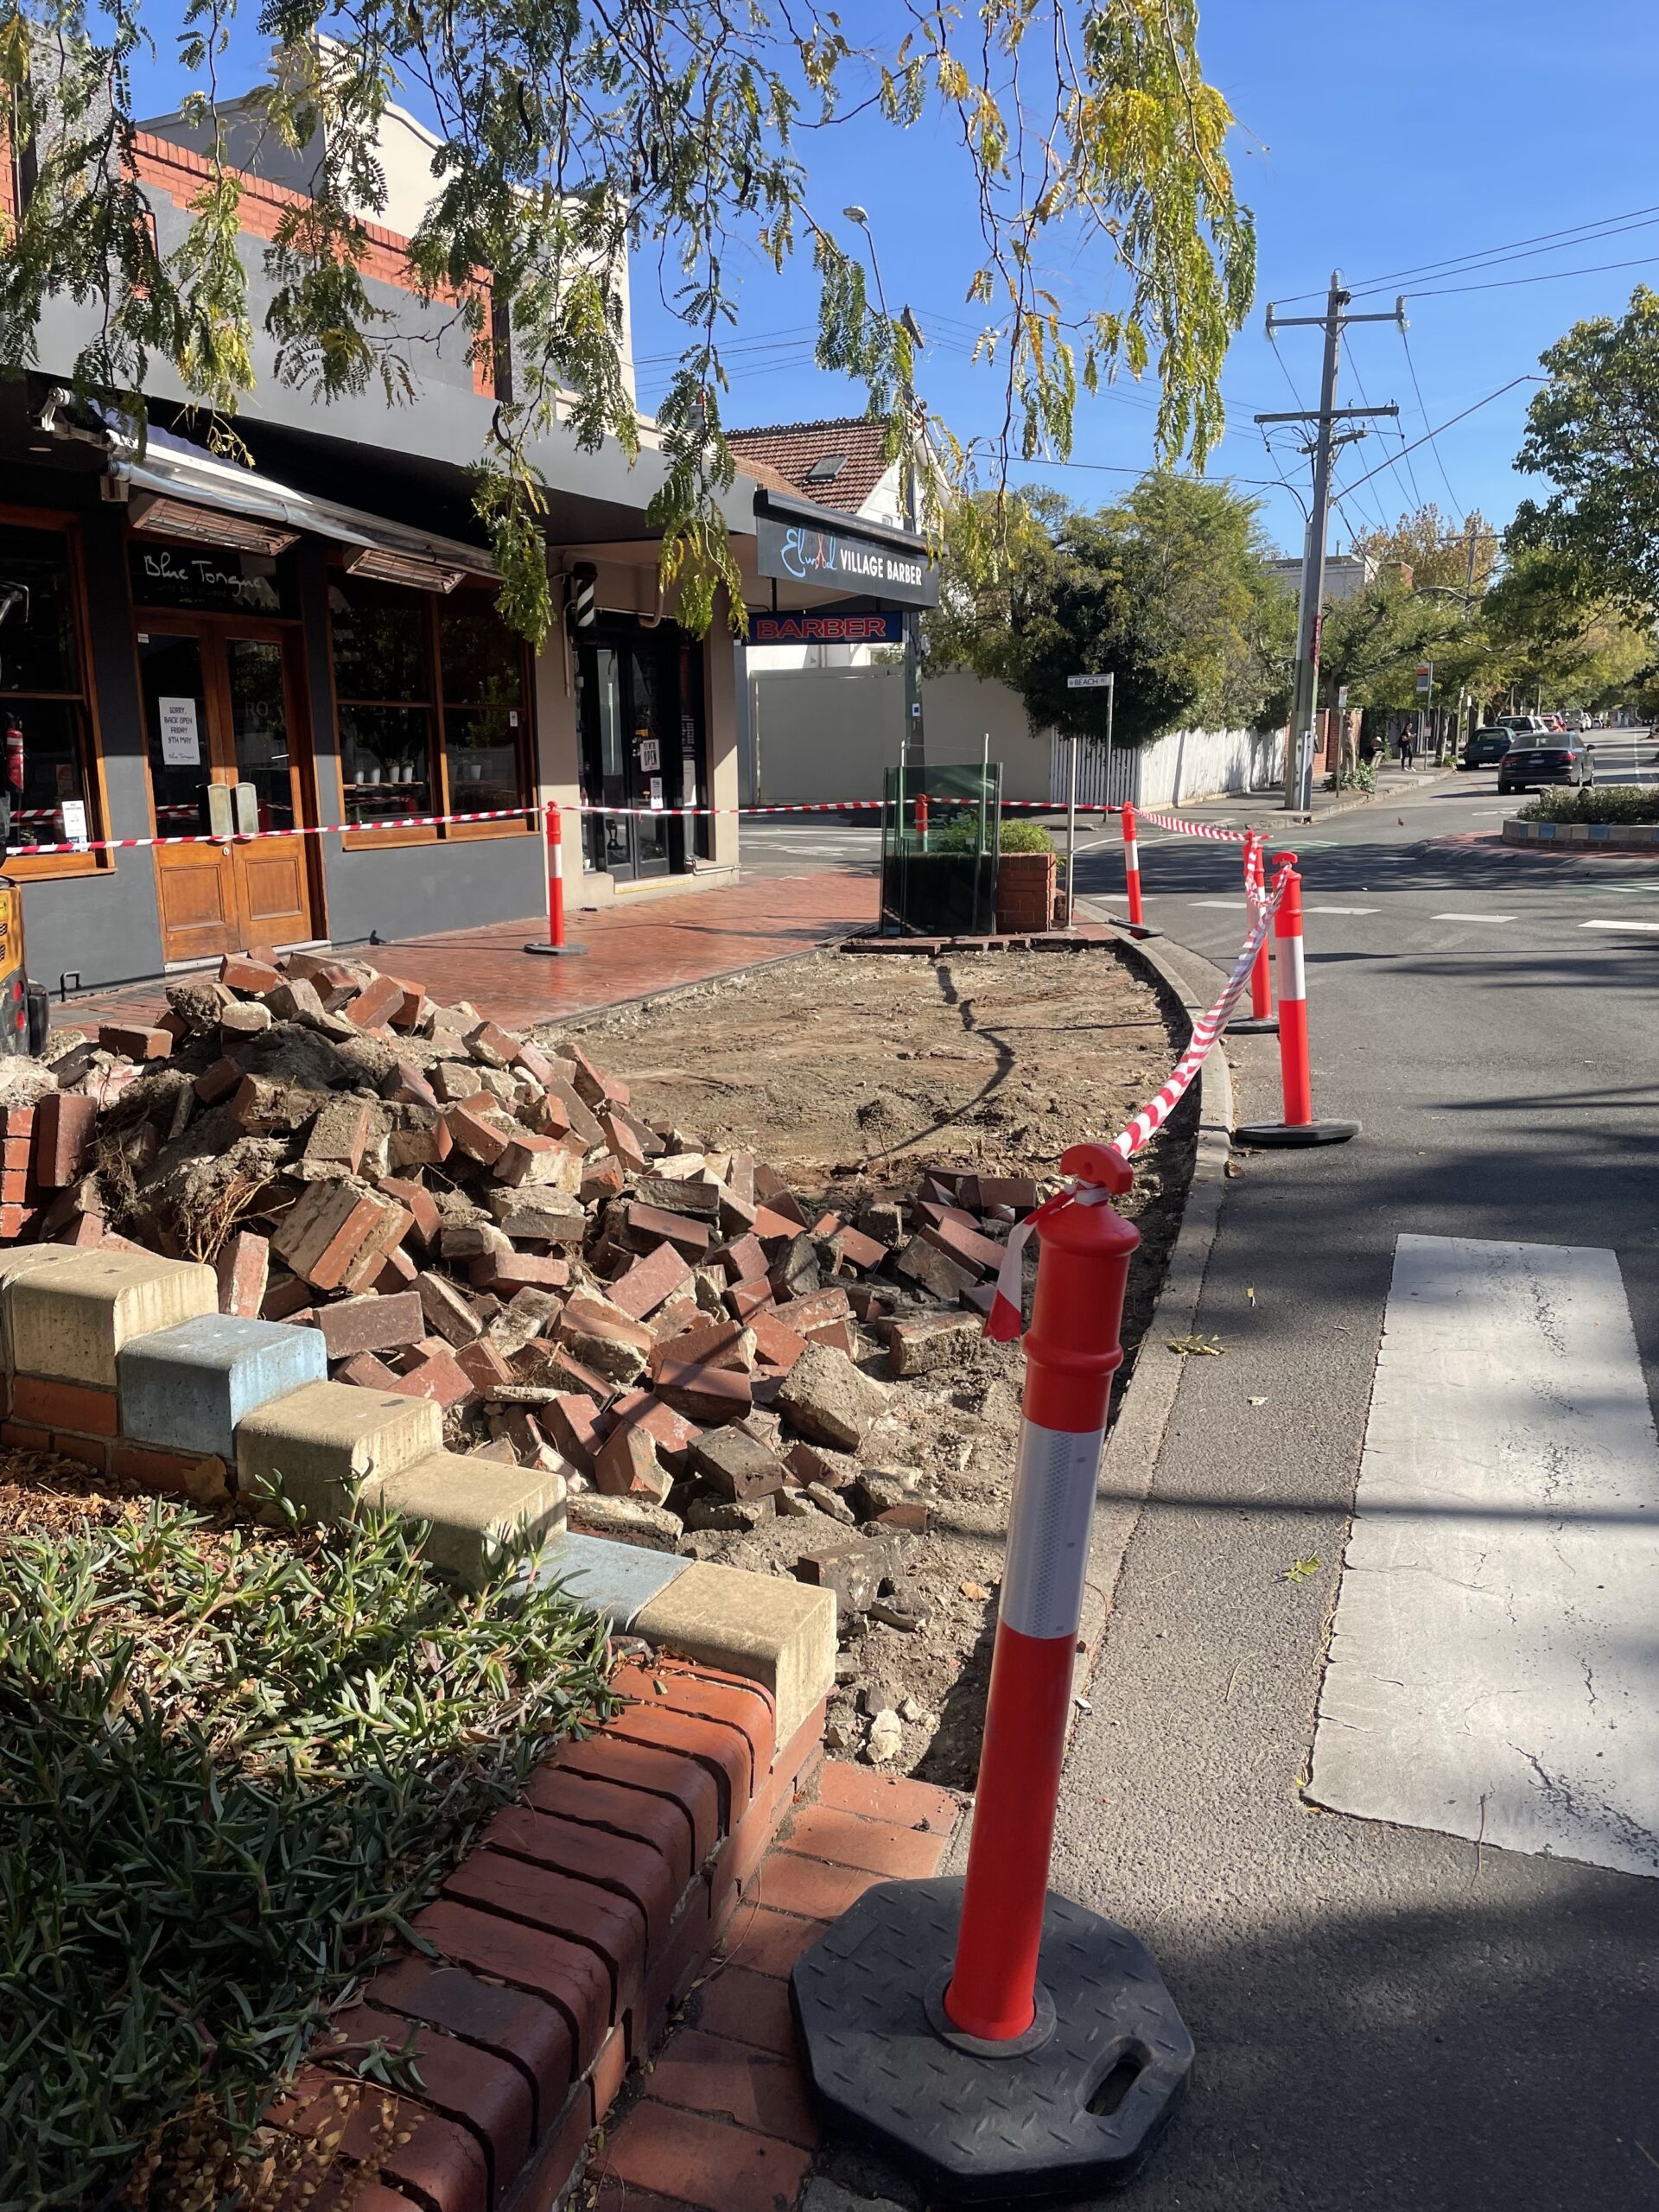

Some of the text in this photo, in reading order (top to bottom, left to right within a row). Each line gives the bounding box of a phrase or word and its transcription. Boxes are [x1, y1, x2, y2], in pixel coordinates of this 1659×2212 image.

[143, 551, 263, 597] Blue Tongue
[780, 528, 922, 586] Elwood VILLAGE BARBER
[756, 617, 887, 639] BARBER
